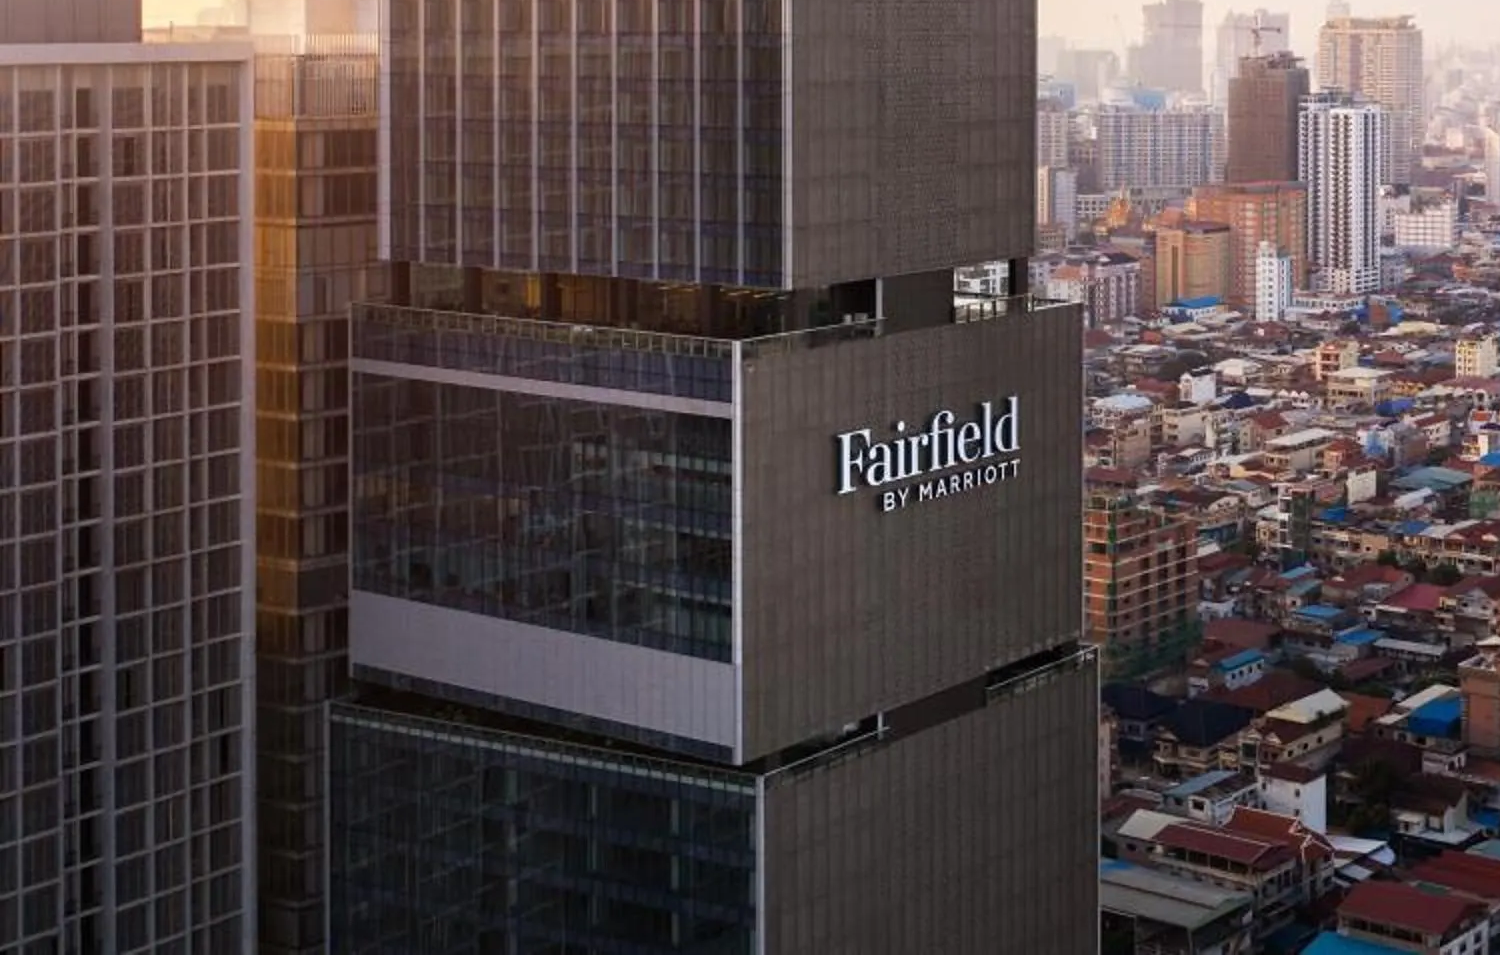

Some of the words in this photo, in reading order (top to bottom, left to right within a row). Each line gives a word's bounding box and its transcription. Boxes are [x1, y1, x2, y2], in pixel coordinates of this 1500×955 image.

[837, 395, 1021, 495] Fairfield
[882, 487, 910, 513] BY
[918, 458, 1021, 503] MARRIOTT
